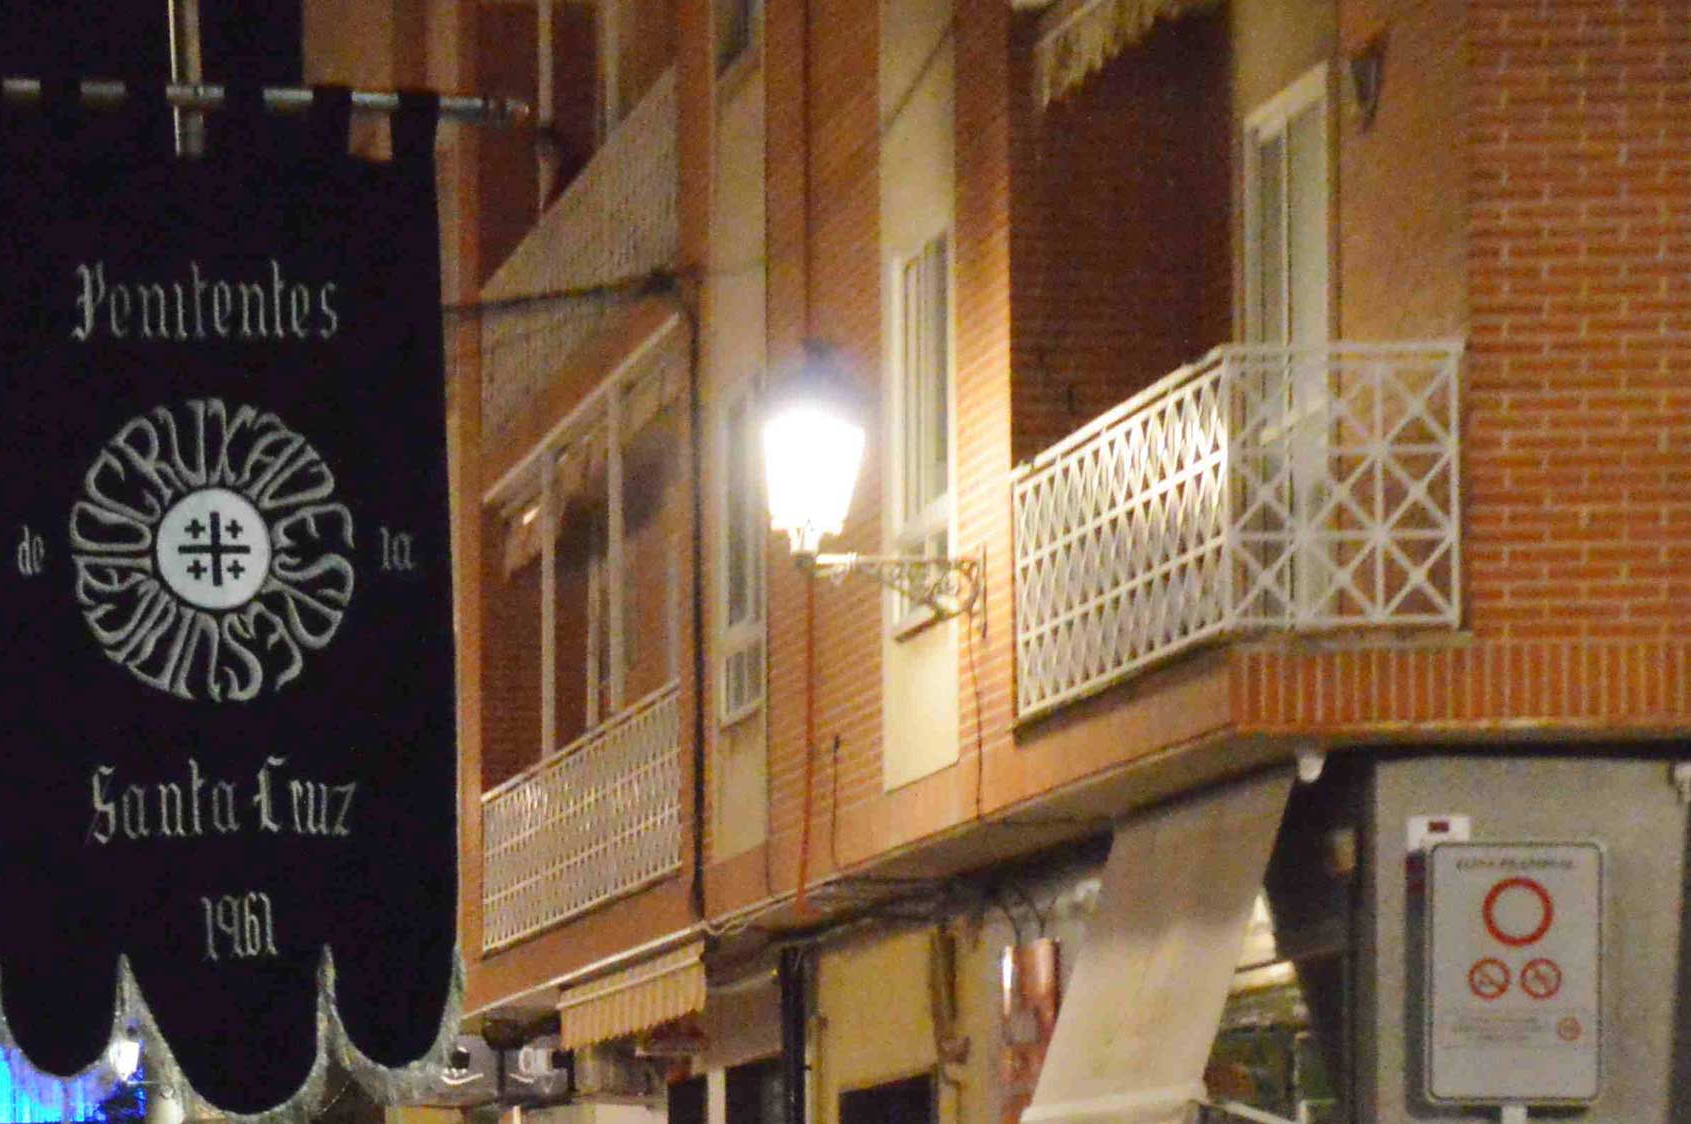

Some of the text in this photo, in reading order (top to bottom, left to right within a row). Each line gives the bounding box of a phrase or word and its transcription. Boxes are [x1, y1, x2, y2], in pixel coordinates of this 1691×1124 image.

[71, 258, 338, 342] Penitentes
[17, 524, 45, 577] de
[379, 526, 413, 571] la
[88, 755, 357, 844] Santa Cruz
[199, 891, 278, 961] 1961
